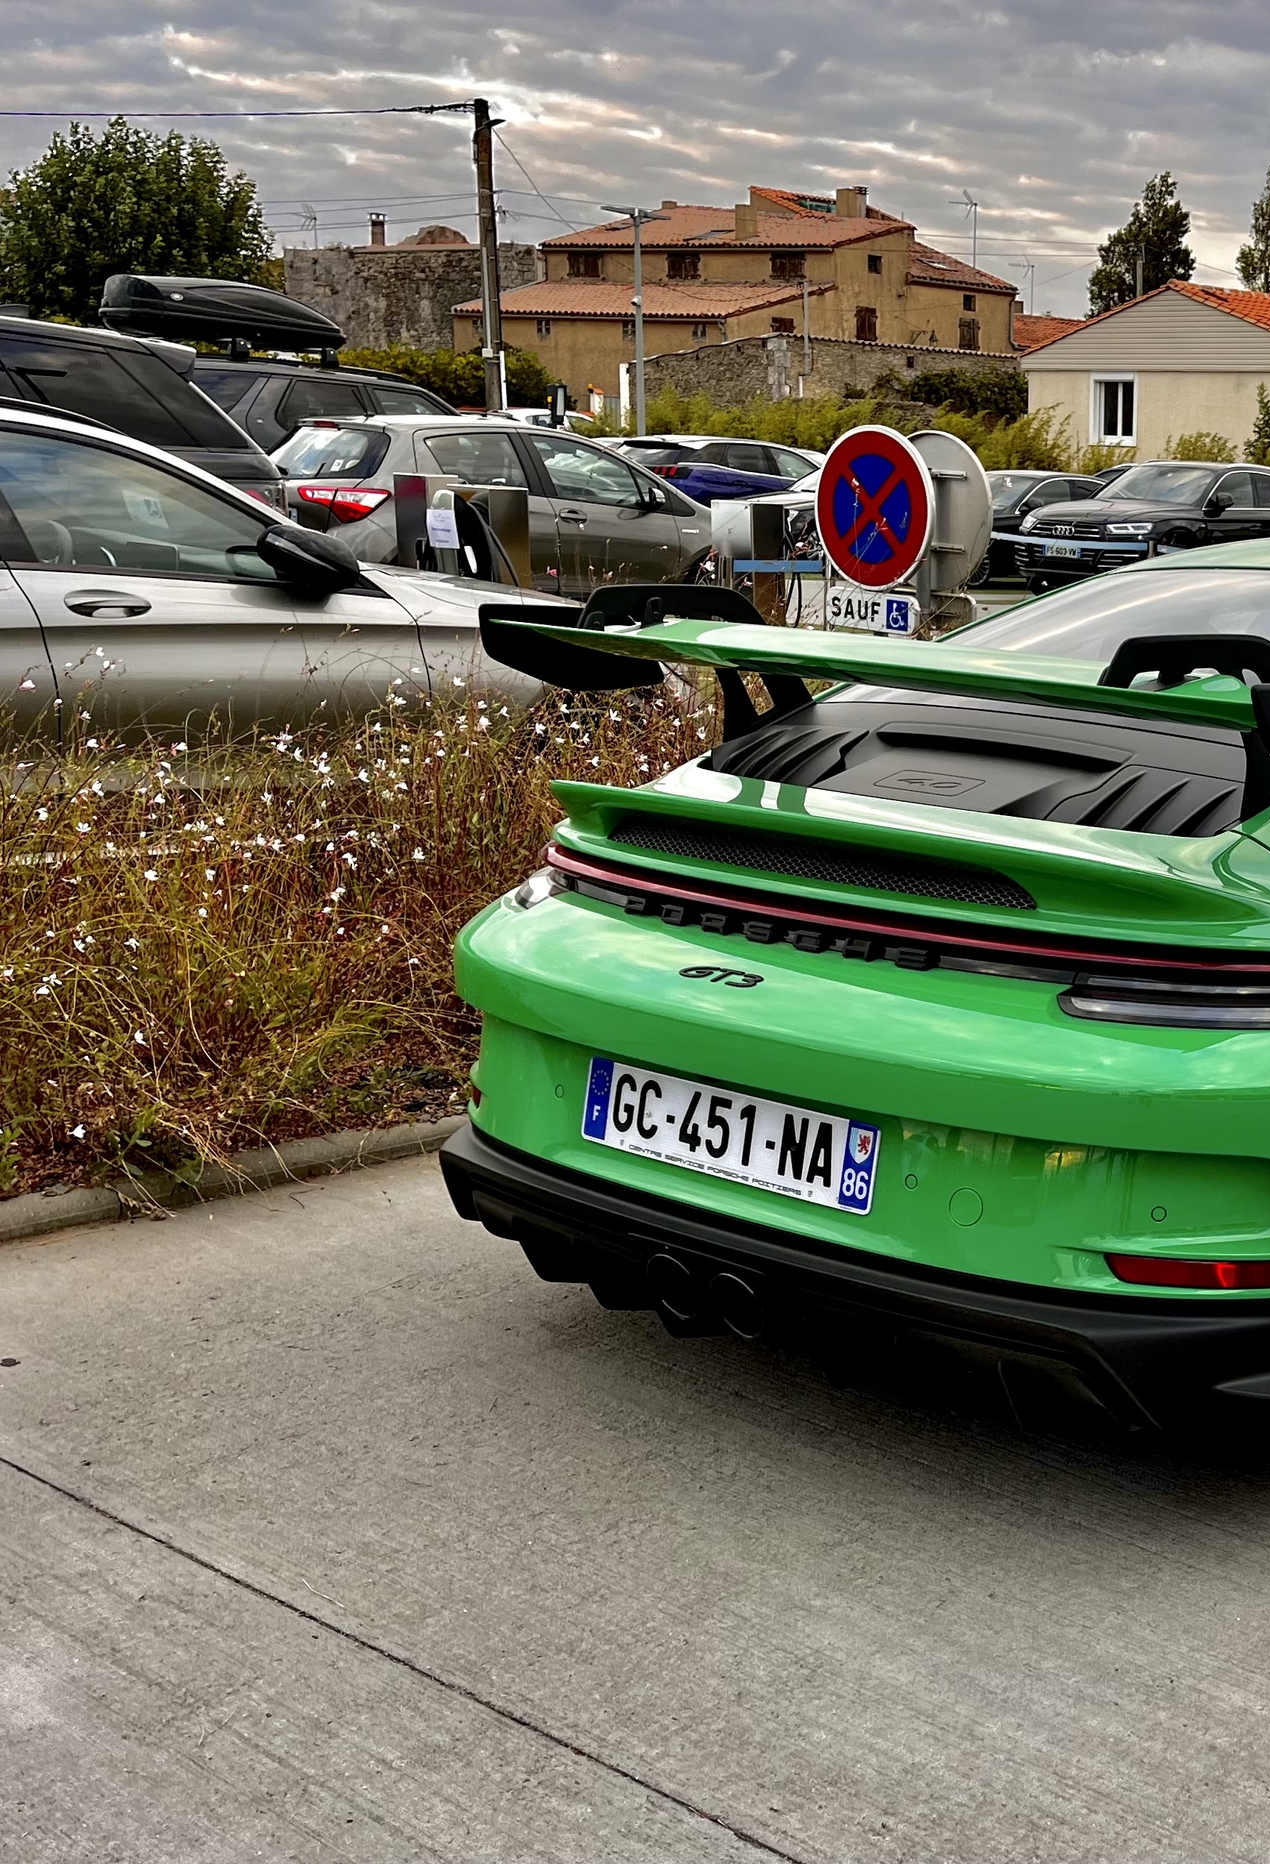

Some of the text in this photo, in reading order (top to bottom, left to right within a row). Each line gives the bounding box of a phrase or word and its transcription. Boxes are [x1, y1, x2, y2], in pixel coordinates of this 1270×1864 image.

[831, 596, 881, 622] SAUF
[625, 895, 931, 970] PORSCHE
[679, 965, 765, 988] GT3
[592, 1104, 602, 1122] F
[612, 1073, 834, 1188] GC-451-NA
[628, 1144, 802, 1196] CENTRE SERVICE PORSCHE POITIERS
[842, 1167, 870, 1200] 86
